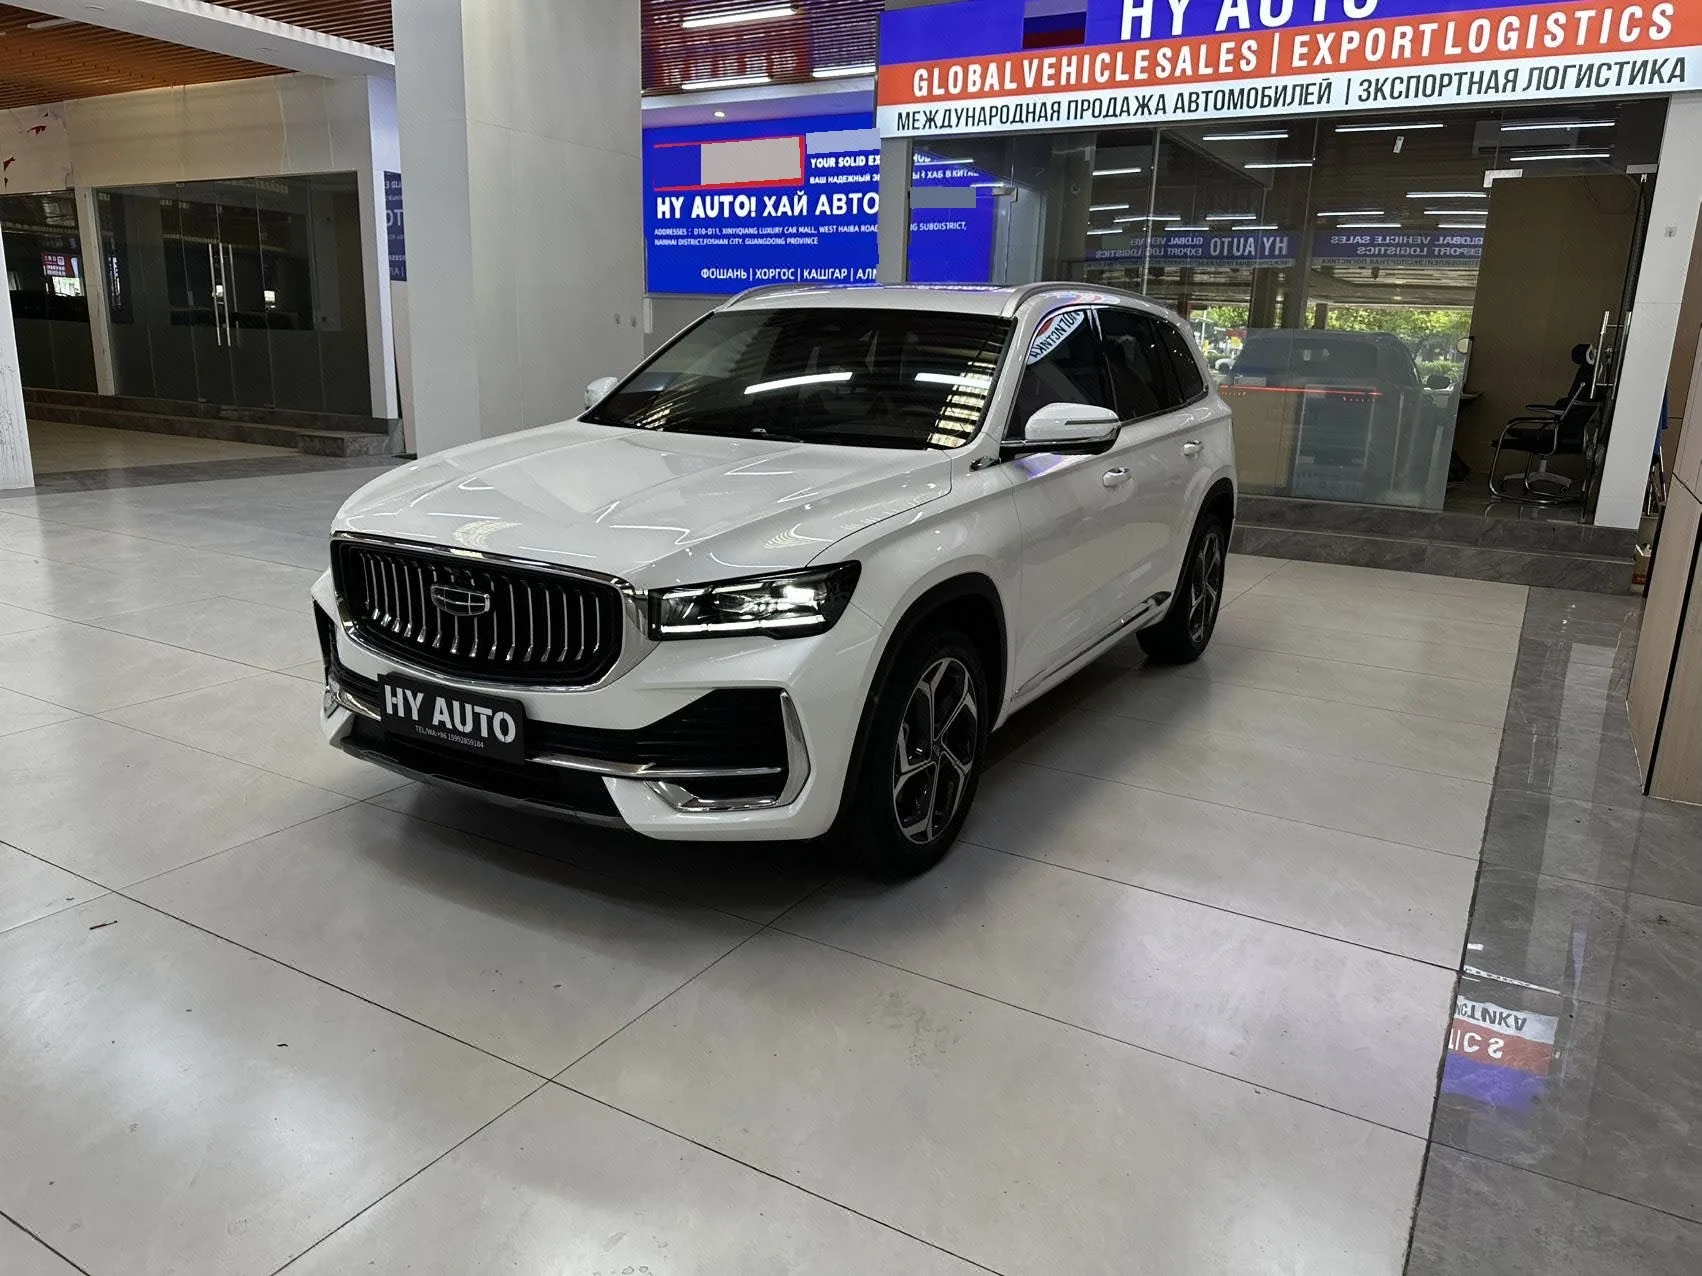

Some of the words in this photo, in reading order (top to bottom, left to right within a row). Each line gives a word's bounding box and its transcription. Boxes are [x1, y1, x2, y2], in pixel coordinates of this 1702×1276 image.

[1121, 0, 1188, 41] HY
[897, 101, 1061, 131] МЕЖДУНАРОДНАЯ
[1067, 94, 1166, 120] ПРОДАЖА
[1173, 78, 1332, 113] АВТОМОБИЛЕЙ
[1525, 56, 1686, 93] ЛОГИСТИКА
[810, 157, 836, 168] YOUR
[838, 155, 866, 167] SOLID
[809, 176, 827, 184] ВАШ
[828, 173, 871, 184] НАДЕЖНЫЙ
[927, 170, 943, 179] ХАБ
[656, 196, 685, 219] HY
[691, 195, 757, 219] AUTO!
[762, 190, 808, 217] ХАЙ
[815, 192, 880, 215] АВТО
[784, 226, 798, 234] CAR
[819, 225, 837, 233] WEST
[745, 237, 785, 245] GUANGDONG
[786, 237, 818, 245] PROVINCE
[701, 267, 747, 280] ФОШАНЬ
[755, 267, 795, 280] ХОРГОС
[803, 267, 848, 280] КАШГАР
[384, 684, 424, 721] HY
[432, 696, 516, 744] AUTO
